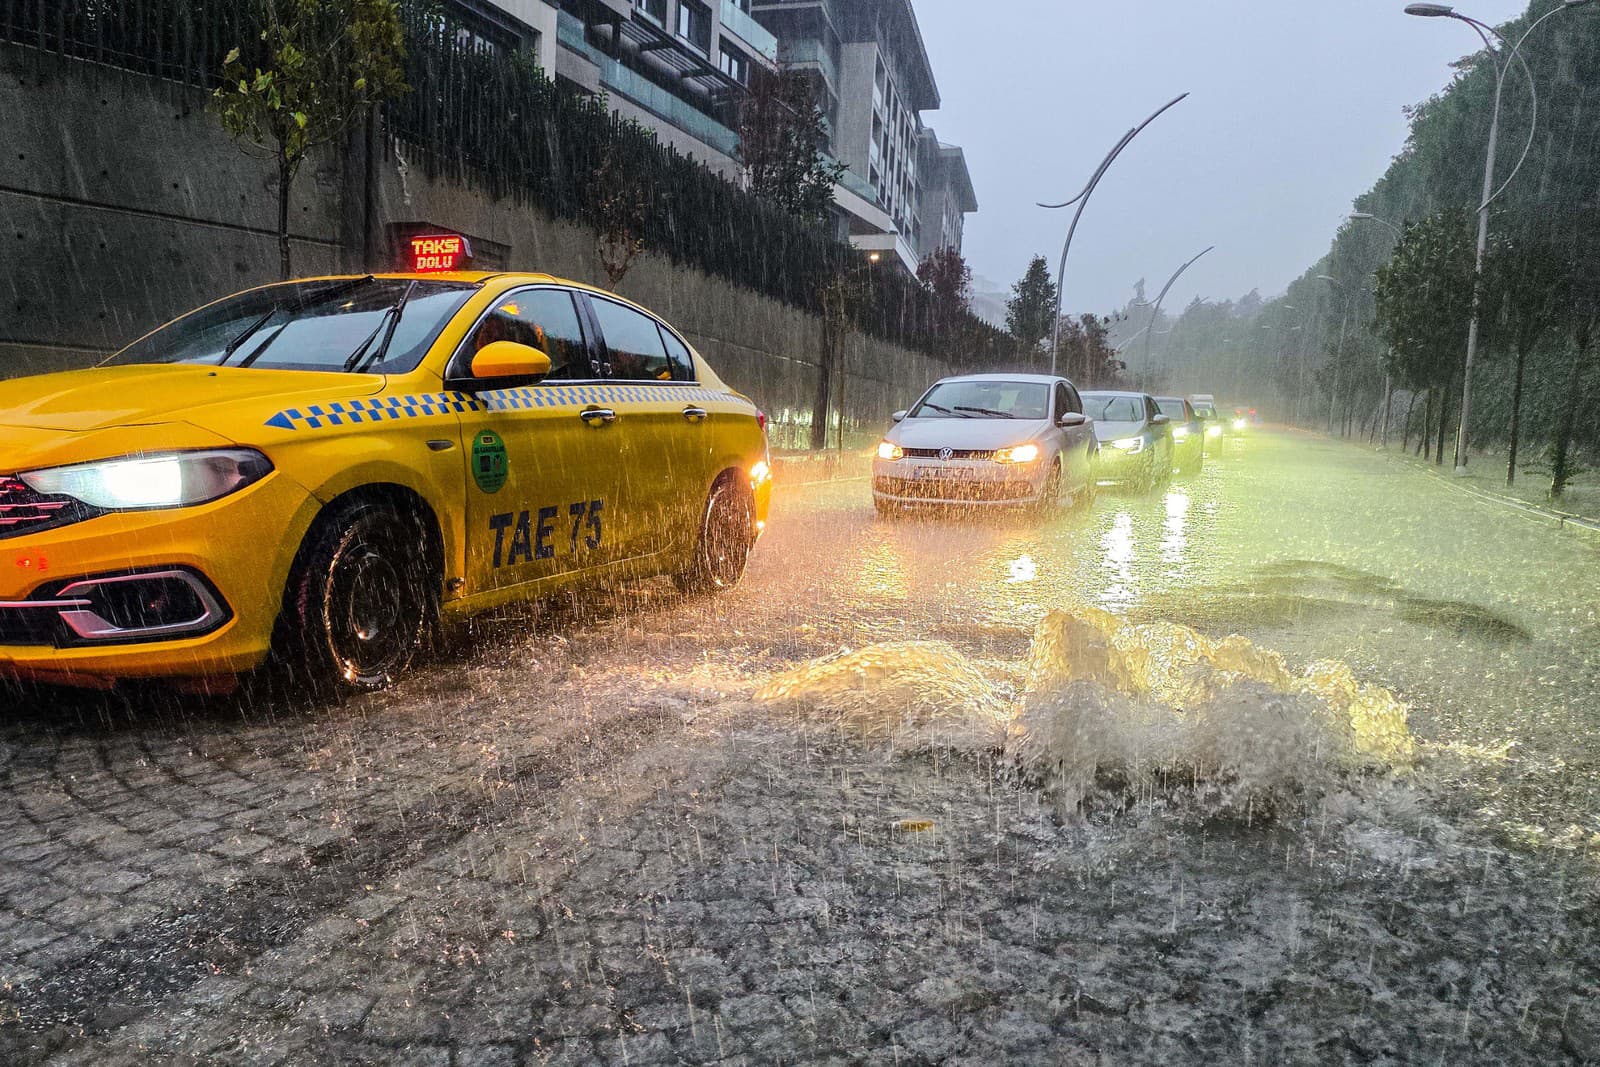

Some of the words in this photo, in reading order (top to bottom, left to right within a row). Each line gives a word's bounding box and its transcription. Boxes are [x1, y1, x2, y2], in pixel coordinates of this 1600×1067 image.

[416, 255, 453, 269] DOLU
[489, 505, 558, 568] TAE
[569, 499, 604, 554] 75
